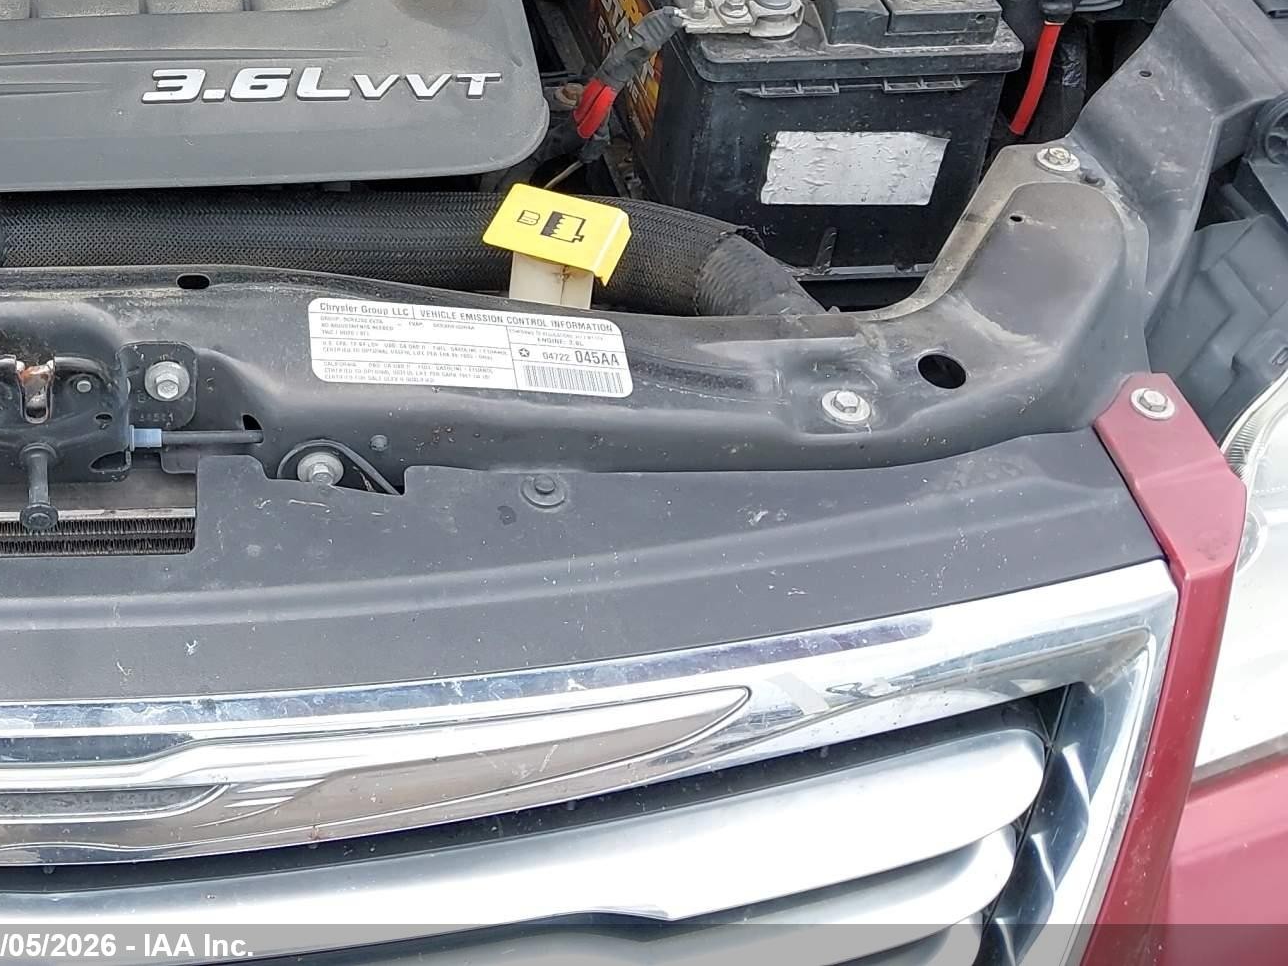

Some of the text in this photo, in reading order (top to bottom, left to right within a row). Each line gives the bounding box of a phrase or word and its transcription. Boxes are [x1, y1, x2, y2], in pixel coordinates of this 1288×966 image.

[320, 302, 613, 332] Chrysler Group LLC VEHICLE EMISSION CONTROL INFORMATION
[543, 350, 620, 366] 04722 045AA
